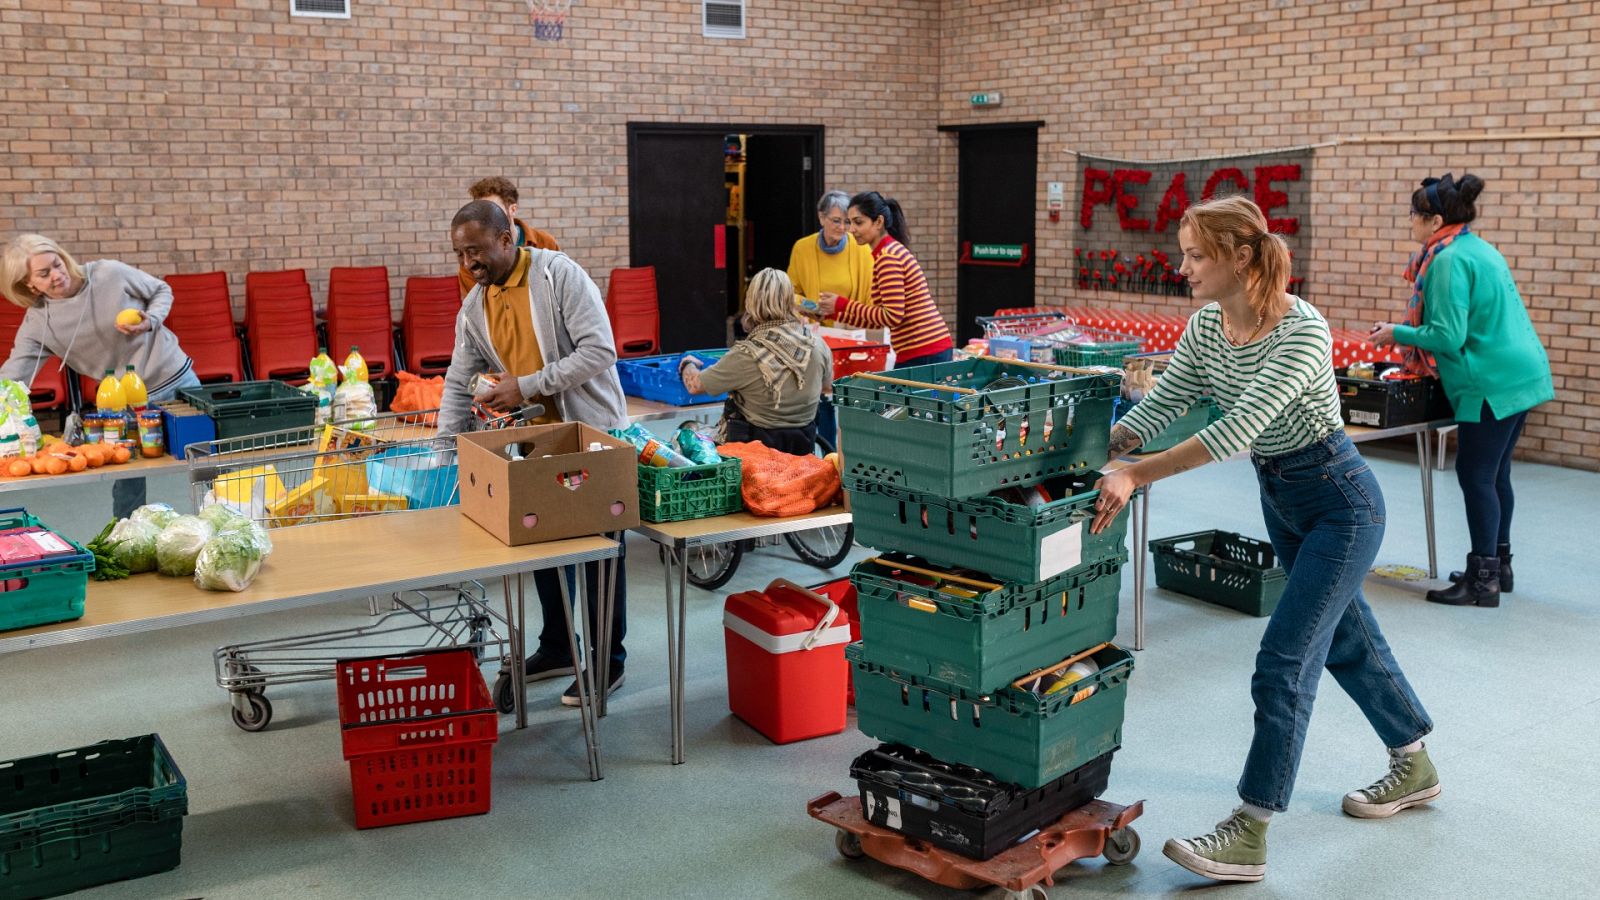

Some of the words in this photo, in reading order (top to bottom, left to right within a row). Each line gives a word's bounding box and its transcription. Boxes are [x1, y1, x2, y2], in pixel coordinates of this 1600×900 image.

[974, 246, 988, 254] Push
[989, 246, 998, 254] bar
[1007, 248, 1022, 256] open
